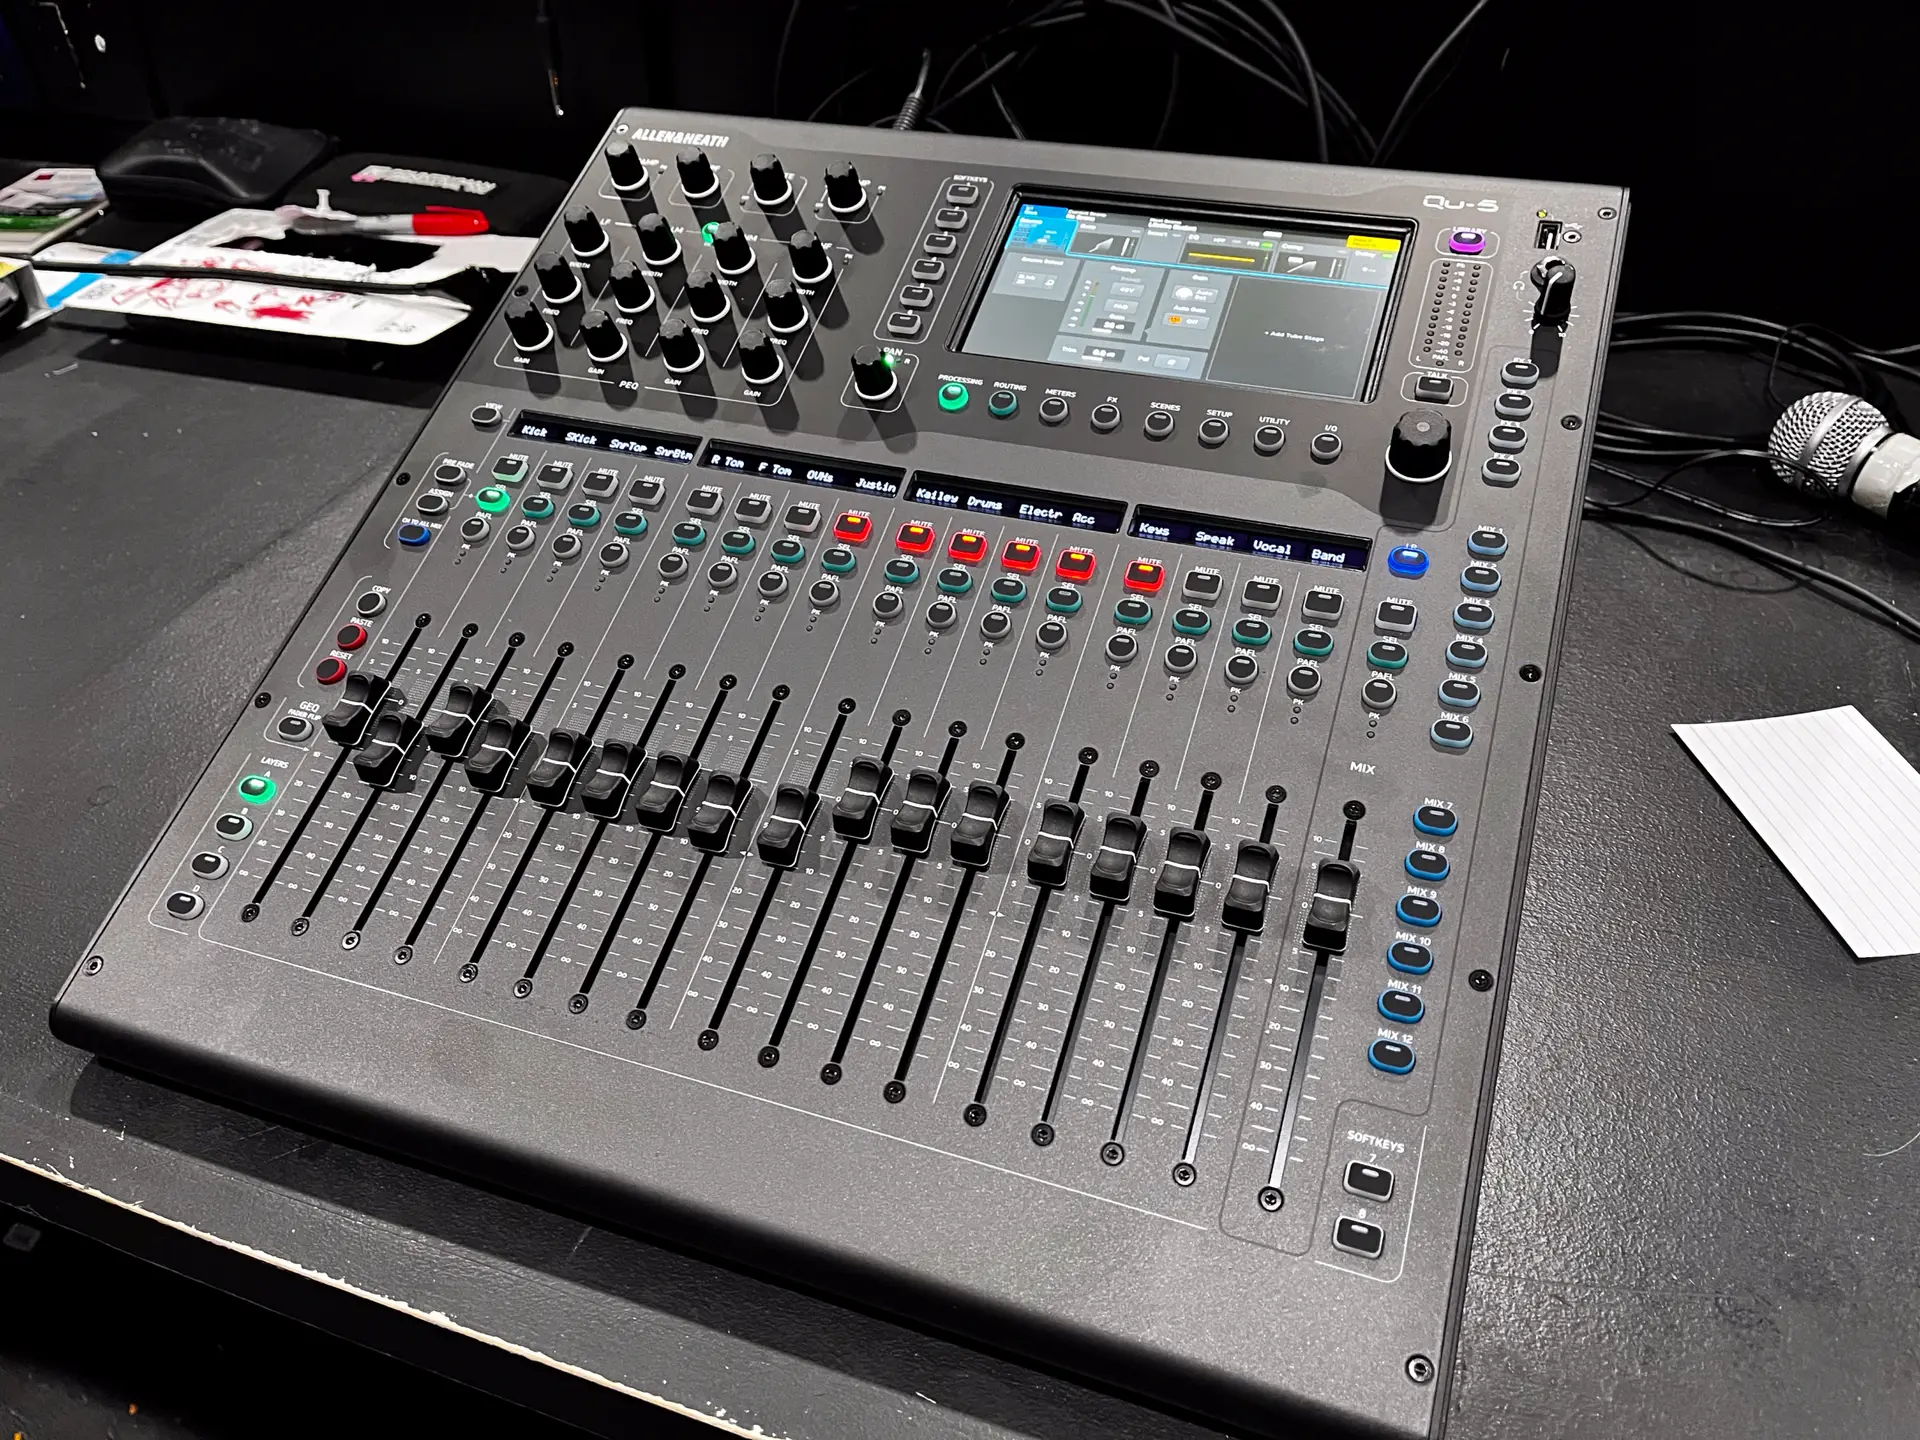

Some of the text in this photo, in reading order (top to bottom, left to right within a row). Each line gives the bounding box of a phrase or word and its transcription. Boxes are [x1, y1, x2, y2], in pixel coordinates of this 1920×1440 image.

[631, 128, 730, 148] ALLEN&HEATH
[1452, 226, 1487, 234] LIBRARY
[542, 308, 560, 316] FREQ
[615, 317, 634, 326] FREQ
[690, 327, 709, 336] FREQ
[513, 355, 530, 364] GAIN
[1427, 371, 1448, 379] TALK
[664, 378, 682, 386] GAIN
[938, 374, 983, 386] PROCESSING
[618, 380, 639, 391] PEQ
[993, 381, 1027, 391] ROUTING
[743, 389, 761, 398] GAIN
[1045, 388, 1077, 398] METERS
[1107, 396, 1118, 404] FX
[1150, 401, 1181, 412] SCENES
[1206, 409, 1233, 418] SETUP
[1259, 416, 1290, 426] UTILITY
[1324, 424, 1338, 432] I/O
[522, 425, 548, 437] Kick
[565, 432, 597, 445] SKick
[609, 439, 648, 453] SnrTop
[509, 453, 529, 461] MUTE
[554, 460, 574, 468] MUTE
[598, 468, 618, 476] MUTE
[725, 457, 745, 469] Tom
[758, 462, 766, 472] F
[772, 464, 792, 477] Tom
[855, 478, 896, 493] Justin
[644, 475, 665, 483] MUTE
[702, 484, 723, 493] MUTE
[750, 492, 771, 502] MUTE
[798, 501, 820, 510] MUTE
[916, 488, 1095, 524] Kailey Drums Electr Acc
[476, 511, 492, 520] PAFL
[848, 509, 870, 517] MUTE
[520, 520, 537, 528] PAFL
[910, 519, 933, 528] MUTE
[566, 528, 584, 536] PAFL
[962, 528, 985, 537] MUTE
[1477, 524, 1497, 533] MIX
[613, 536, 630, 544] PAFL
[1015, 536, 1039, 545] MUTE
[1139, 523, 1346, 564] Keys Speak Vocal Band
[672, 546, 690, 556] PAFL
[1069, 546, 1094, 554] MUTE
[720, 555, 739, 564] PAFL
[900, 554, 914, 562] SEL
[1137, 556, 1162, 566] MUTE
[953, 563, 967, 571] SEL
[1470, 560, 1489, 568] MIX
[770, 564, 789, 574] PAFL
[1195, 566, 1220, 575] MUTE
[821, 573, 840, 582] PAFL
[1006, 572, 1021, 580] SEL
[1254, 575, 1279, 584] MUTE
[372, 585, 392, 594] COPY
[884, 584, 904, 594] PAFL
[1061, 582, 1076, 590] SEL
[1314, 585, 1340, 594] MUTE
[938, 594, 958, 604] PAFL
[1130, 594, 1145, 602] SEL
[1386, 597, 1413, 605] MUTE
[1463, 597, 1482, 605] MIX
[992, 604, 1012, 614] PAFL
[1188, 603, 1203, 611] SEL
[1046, 614, 1068, 624] PAFL
[1247, 613, 1262, 621] SEL
[350, 617, 374, 627] PASTE
[1116, 626, 1137, 636] PAFL
[1308, 623, 1324, 632] SEL
[1175, 636, 1196, 646] PAFL
[1382, 635, 1399, 643] SEL
[1456, 634, 1475, 642] MIX
[329, 650, 354, 660] RESET
[1234, 647, 1256, 657] PAFL
[1296, 658, 1318, 668] PAFL
[1371, 671, 1395, 681] PAFL
[1449, 673, 1468, 681] MIX
[299, 701, 320, 713] GEQ
[287, 708, 322, 721] FADER FLIP
[1369, 712, 1380, 720] PK
[1441, 712, 1461, 721] MIX
[260, 756, 289, 769] LAYERS
[1350, 762, 1376, 775] MIX
[263, 770, 271, 778] A
[293, 779, 304, 787] 20
[1424, 797, 1443, 808] MIX
[275, 809, 286, 817] 30
[217, 846, 225, 854] C
[1416, 841, 1445, 853] MIX 8
[192, 885, 200, 893] D
[1407, 885, 1437, 898] MIX 9
[1396, 931, 1431, 946] MIX 10
[1388, 979, 1421, 995] MIX 11
[1268, 1022, 1281, 1031] 20
[1378, 1028, 1413, 1044] MIX 12
[1260, 1062, 1272, 1071] 30
[1250, 1102, 1263, 1111] 40
[1347, 1130, 1405, 1154] SOFTKEYS
[1369, 1154, 1377, 1162] 7
[1358, 1208, 1367, 1219] 8
